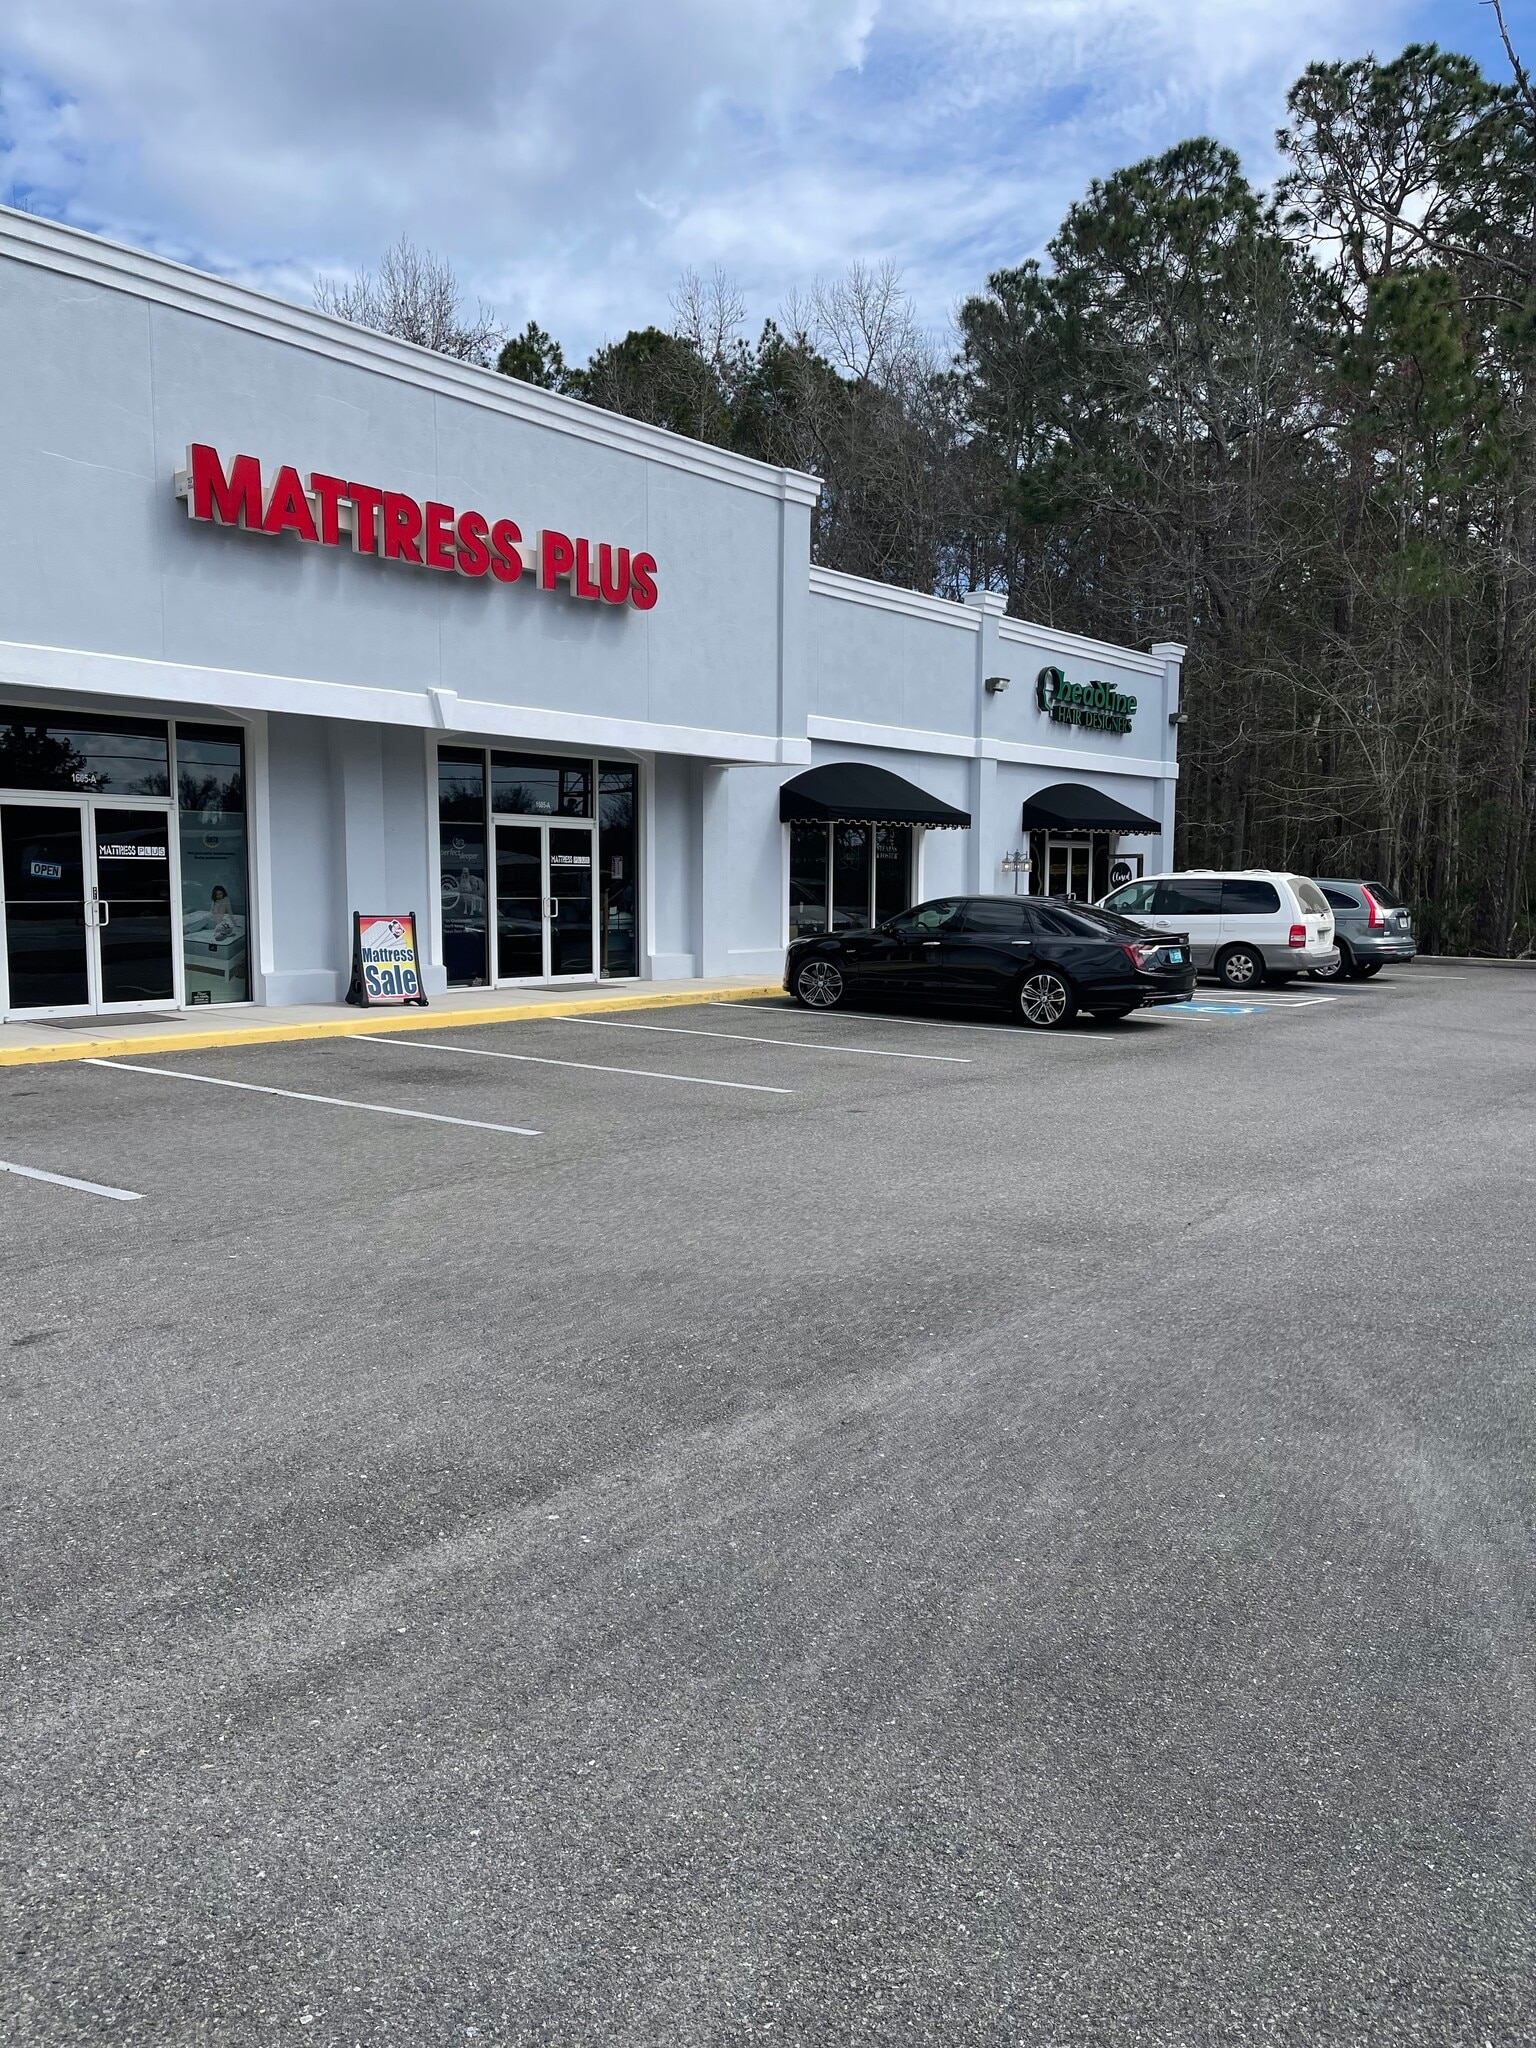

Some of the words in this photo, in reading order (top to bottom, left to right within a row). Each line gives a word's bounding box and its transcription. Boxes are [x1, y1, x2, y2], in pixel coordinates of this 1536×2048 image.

[187, 443, 522, 582] MATTRESS
[537, 530, 658, 610] PLUS
[1058, 706, 1081, 725] HAIR
[1085, 711, 1132, 732] DESIGNERS
[99, 845, 136, 856] MATTRESS
[137, 846, 166, 856] PLUS
[33, 863, 60, 877] OPEN
[362, 947, 414, 963] Mattress
[365, 964, 418, 996] Sale
